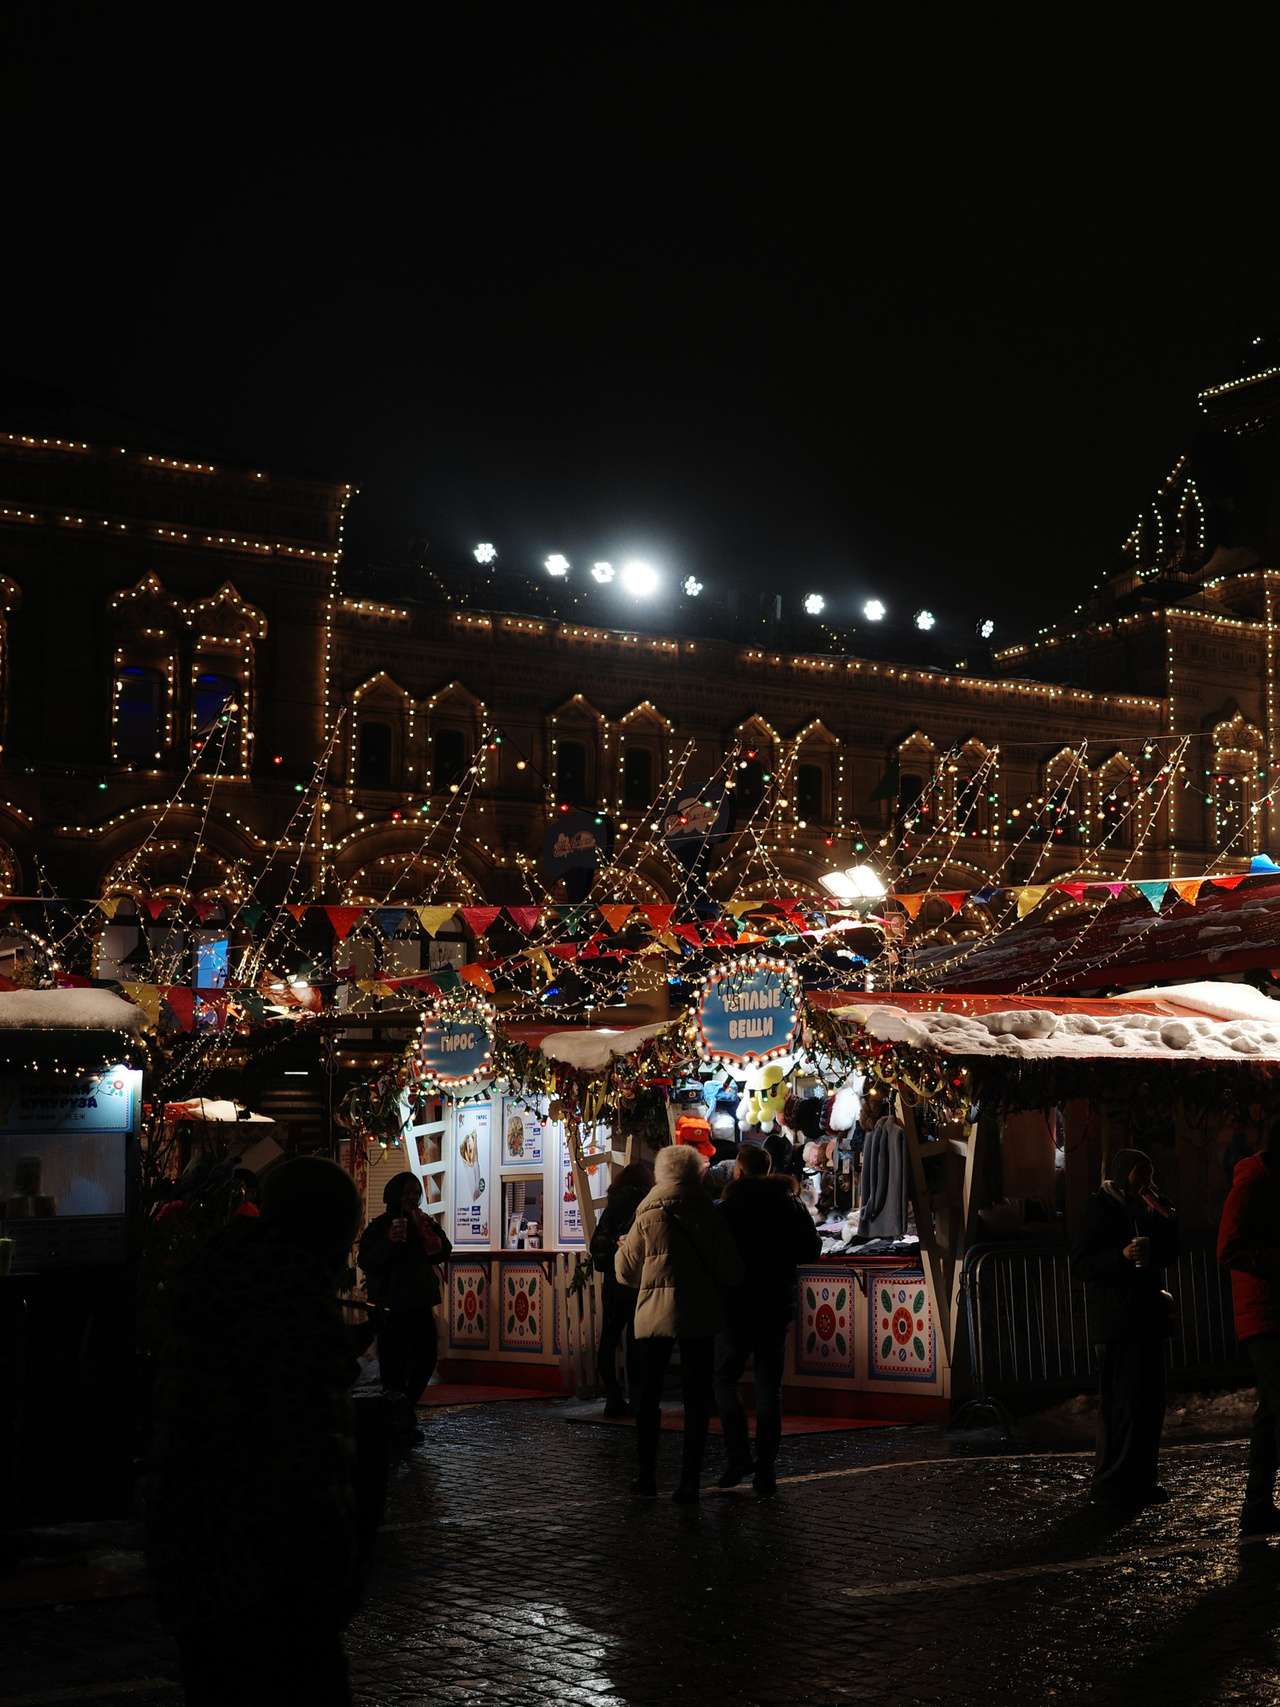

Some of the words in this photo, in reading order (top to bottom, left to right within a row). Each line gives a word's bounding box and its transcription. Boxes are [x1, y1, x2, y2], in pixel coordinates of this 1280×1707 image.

[722, 987, 782, 1013] ТЕПЛЫЕ
[728, 1016, 774, 1040] ВЕЩИ
[440, 1032, 475, 1053] ГИРОС
[21, 1084, 90, 1095] ГОРЯЧАЯ
[20, 1097, 98, 1109] КУКУРУЗА
